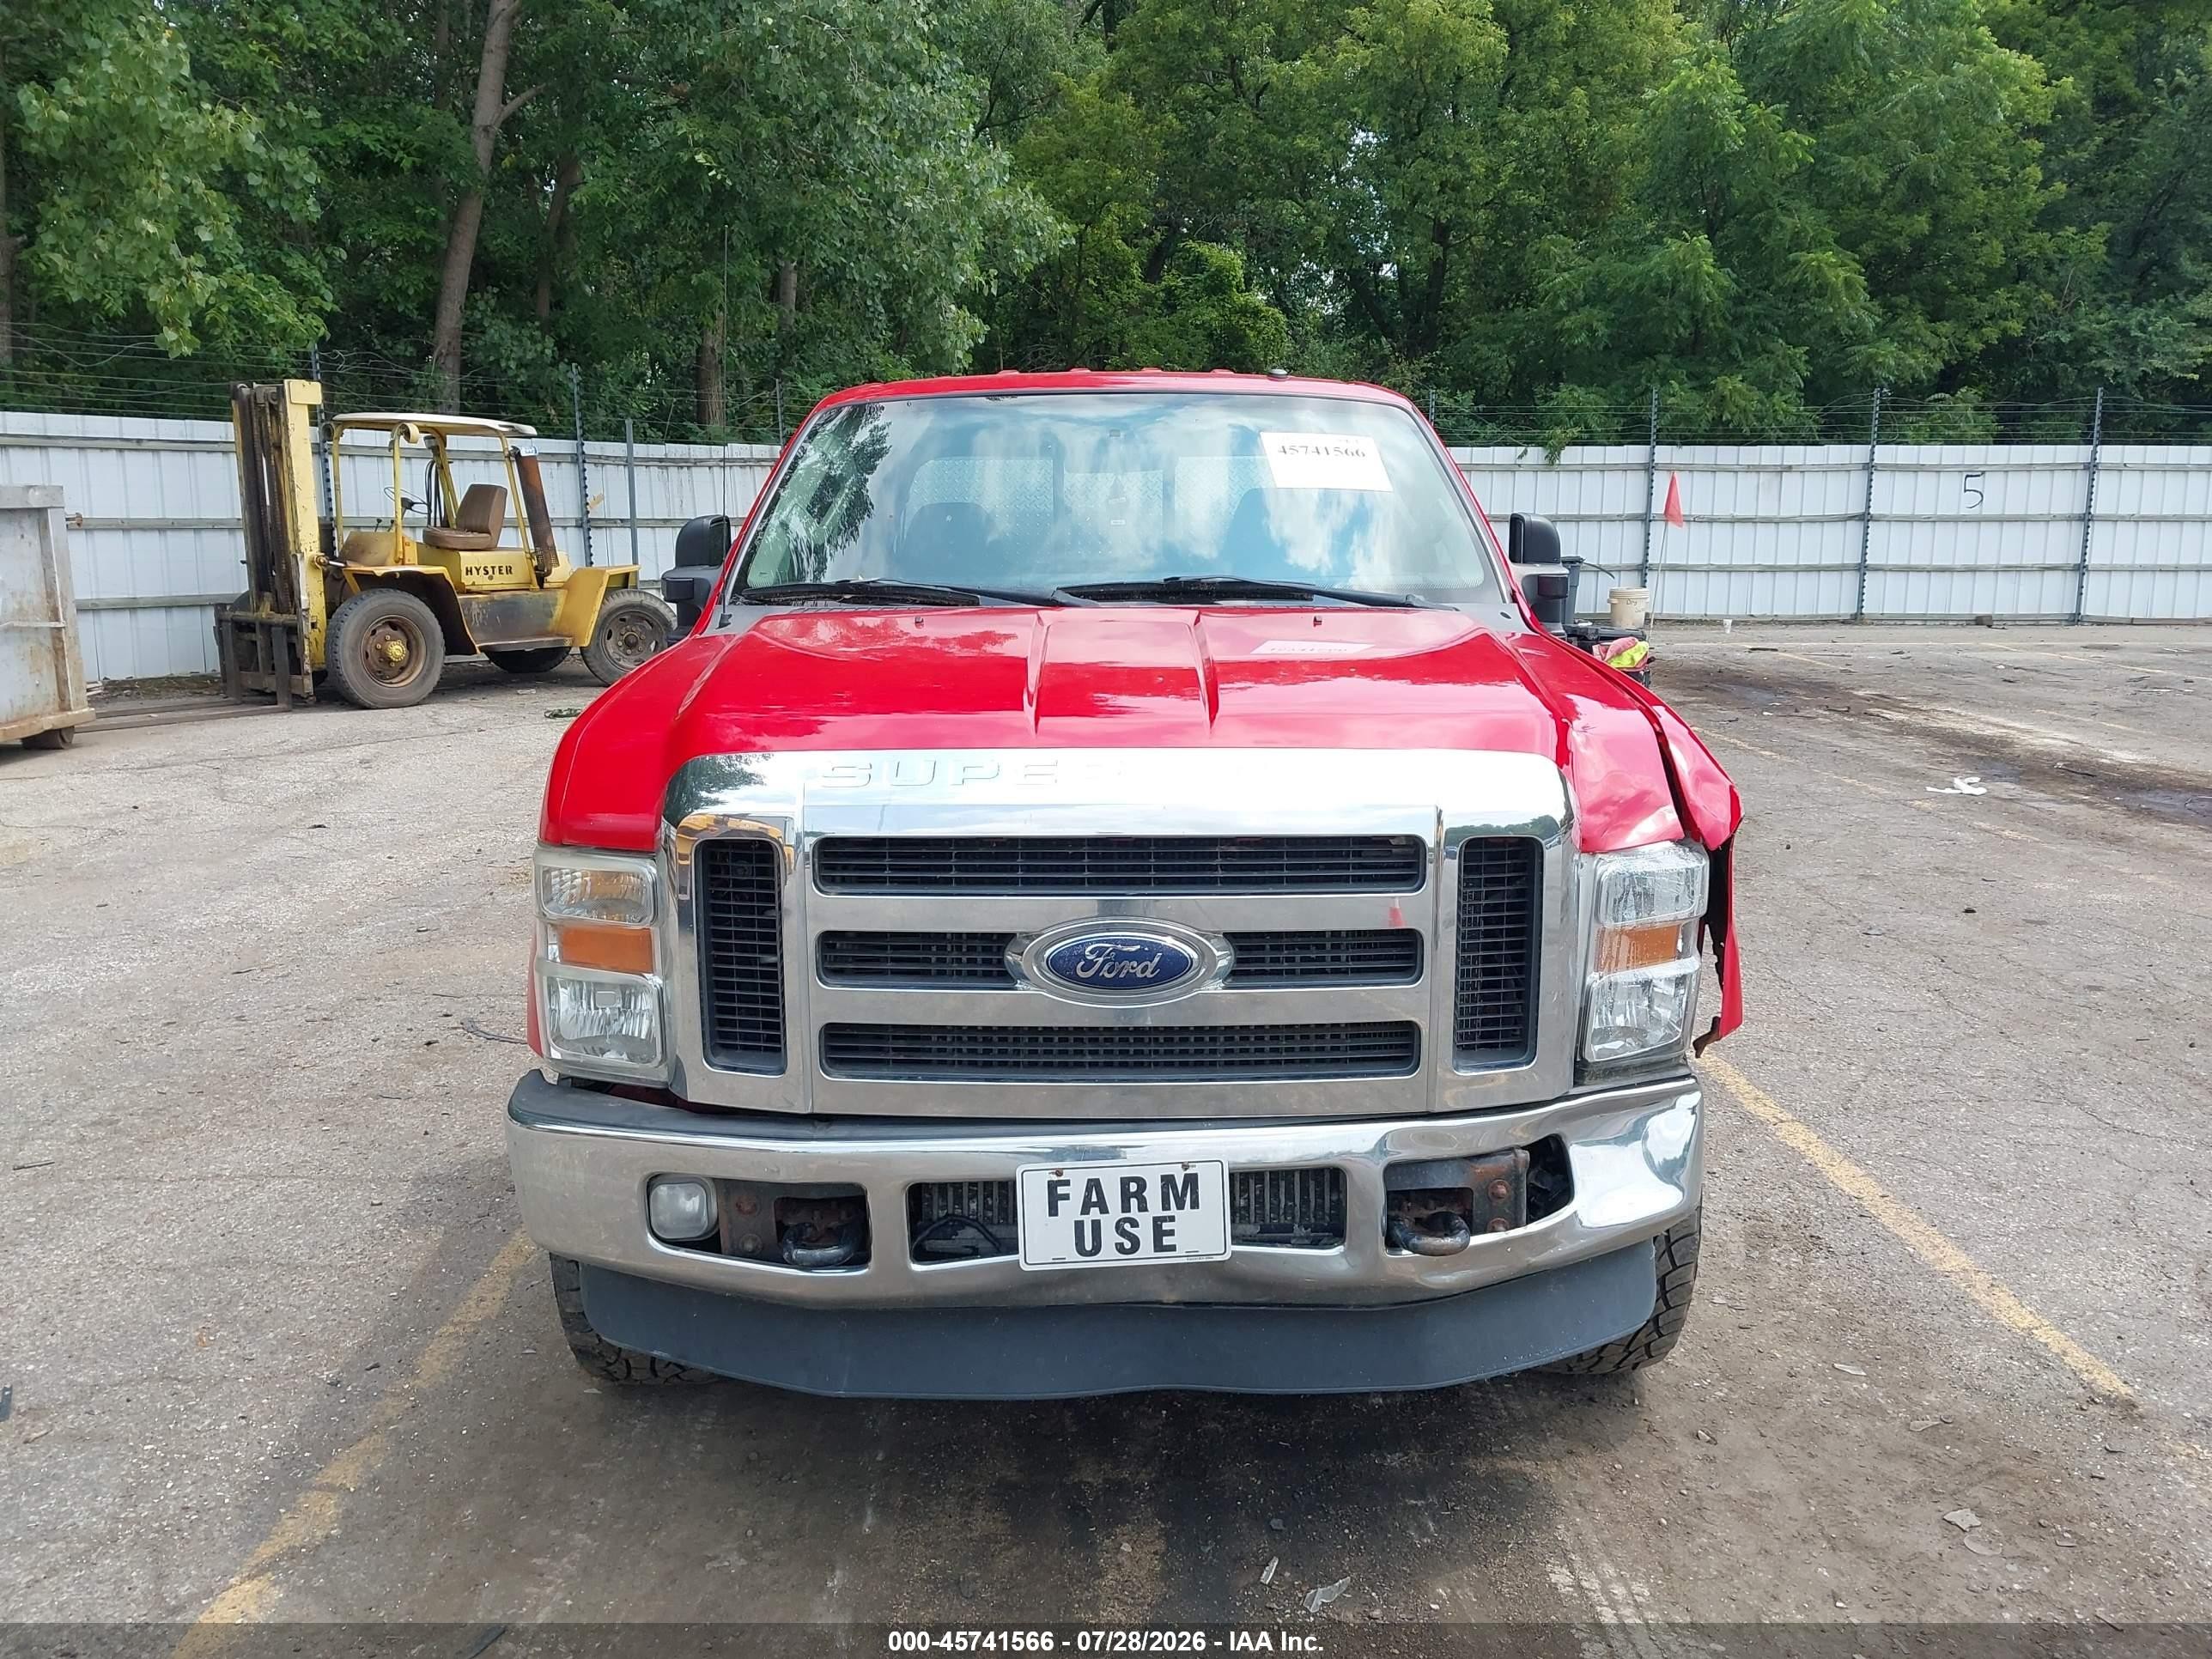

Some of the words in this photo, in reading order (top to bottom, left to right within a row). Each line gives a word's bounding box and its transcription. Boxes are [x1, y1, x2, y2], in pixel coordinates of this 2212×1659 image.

[1277, 445, 1366, 458] 45741566
[1963, 471, 1985, 509] 5
[465, 565, 514, 576] HYSTER
[1076, 943, 1163, 978] Ford
[1047, 1172, 1200, 1218] FARM
[1073, 1215, 1177, 1257] USE
